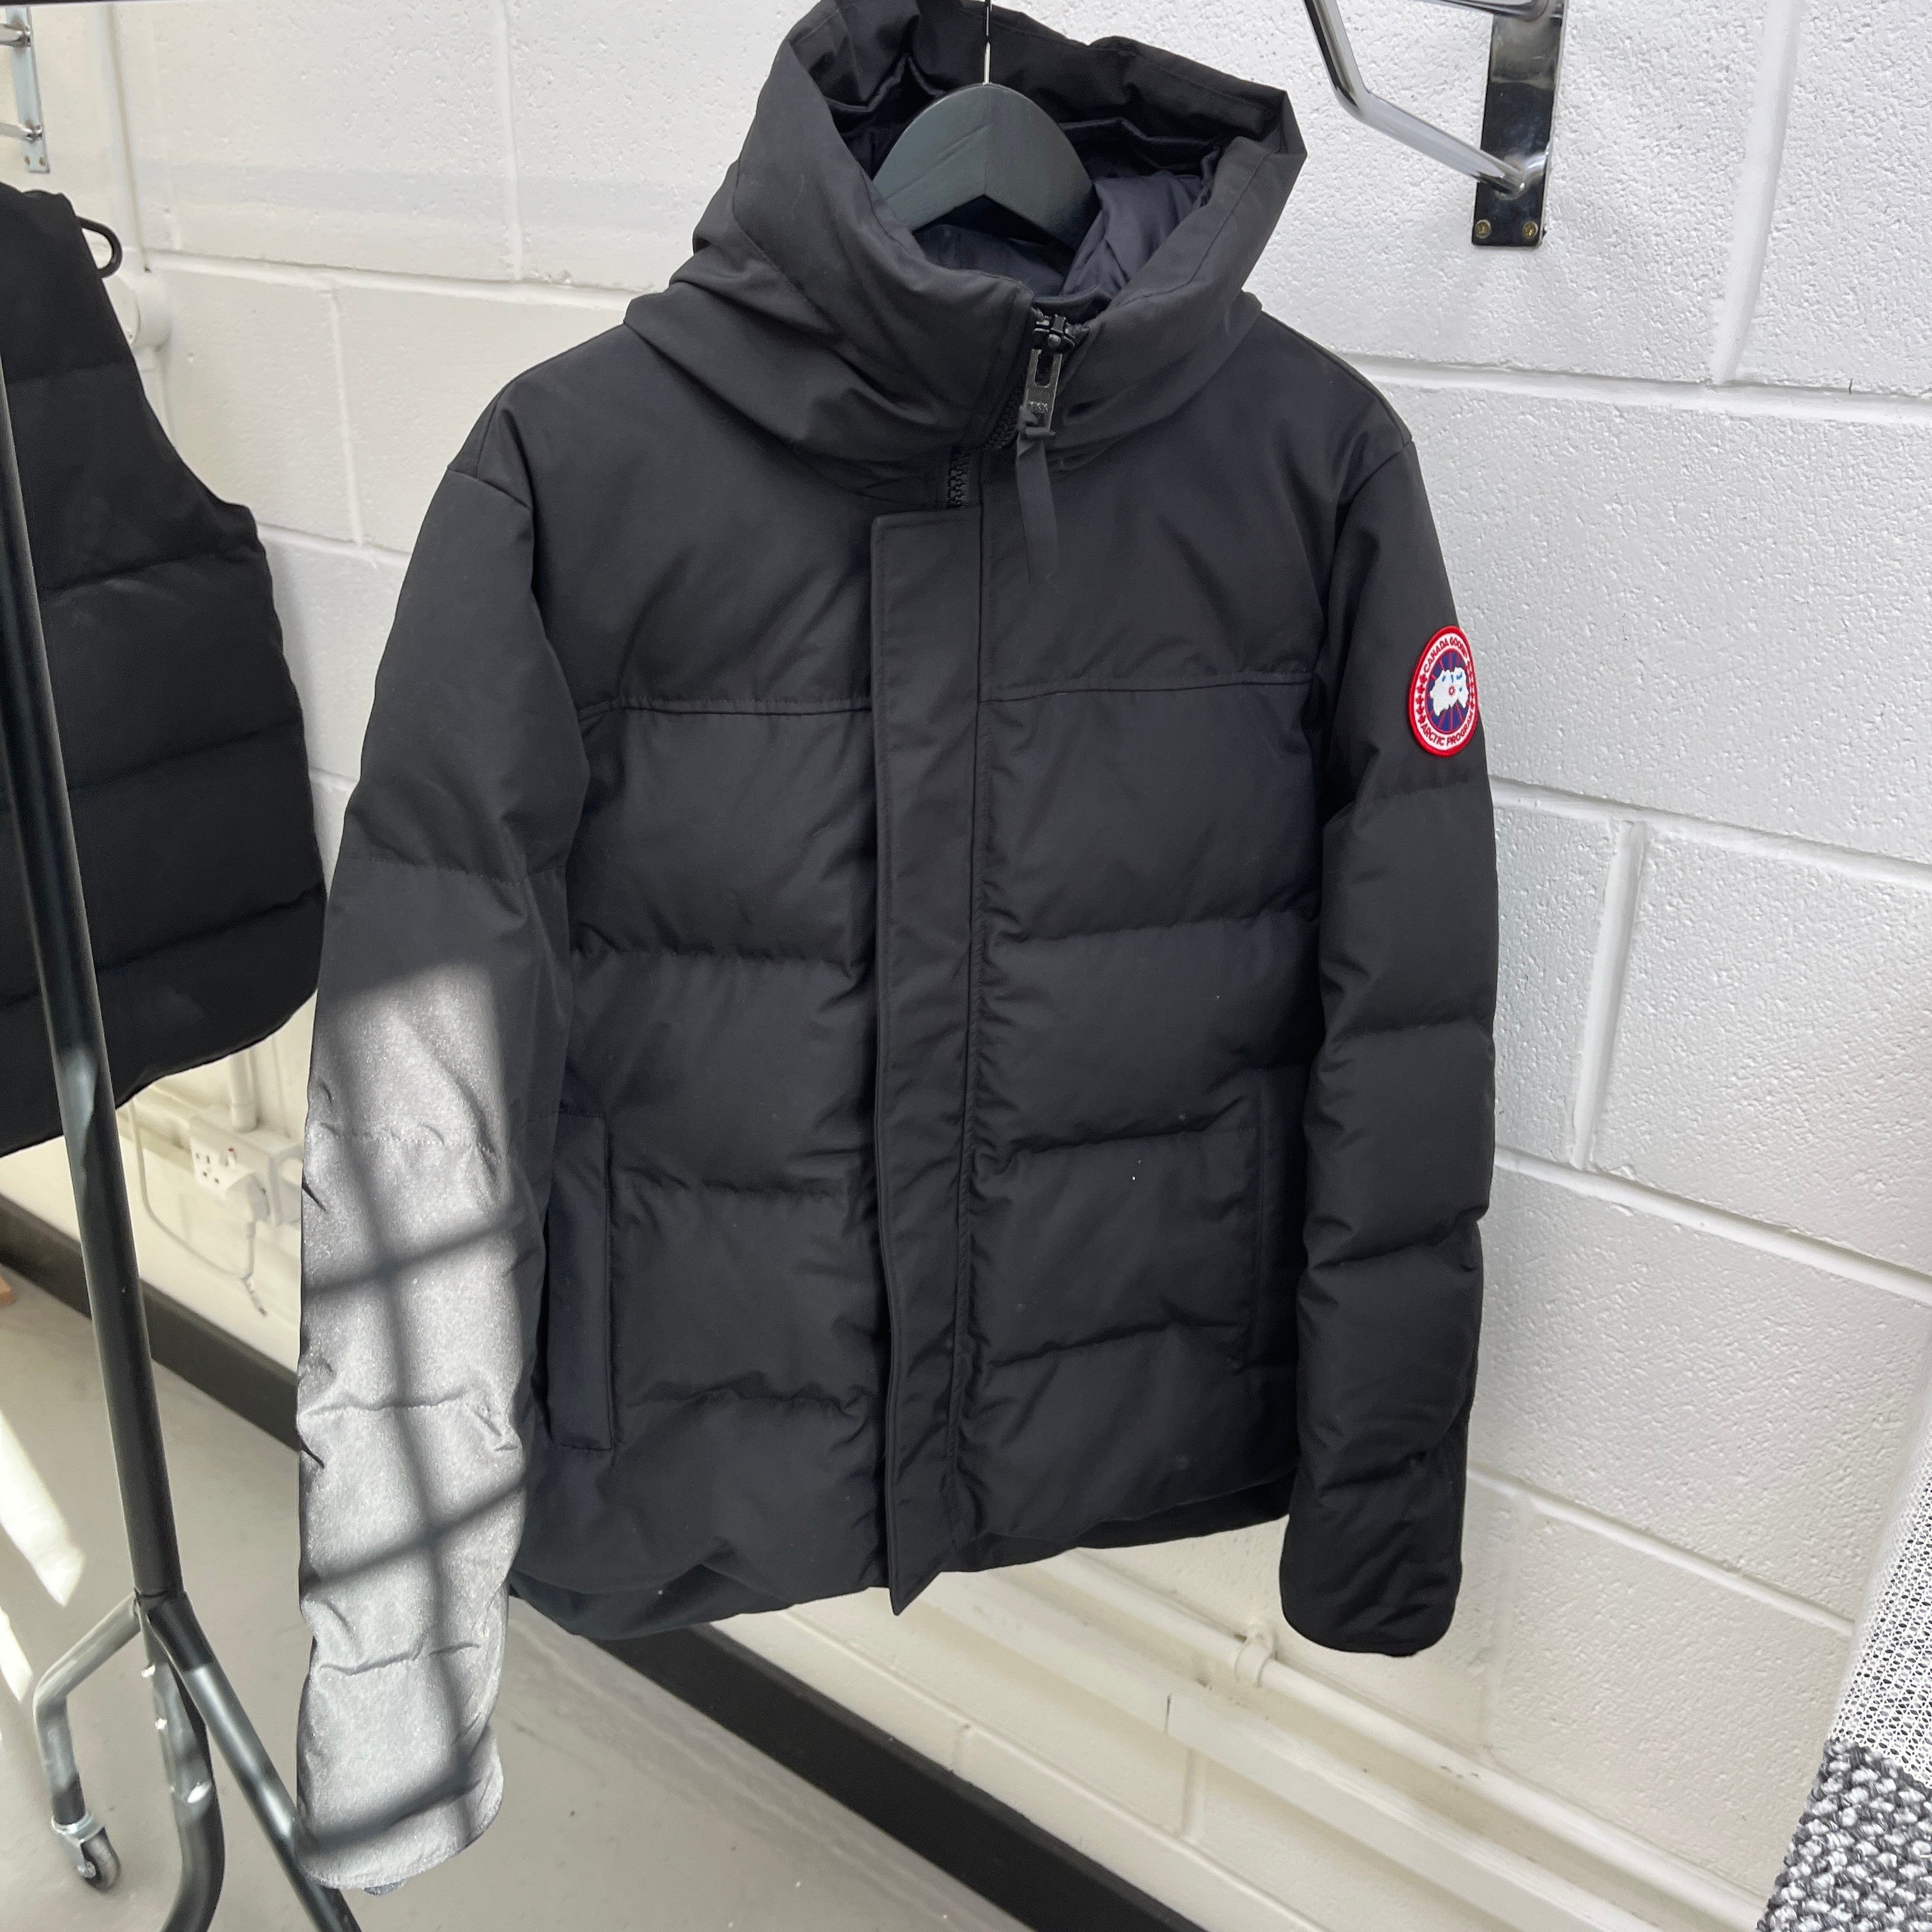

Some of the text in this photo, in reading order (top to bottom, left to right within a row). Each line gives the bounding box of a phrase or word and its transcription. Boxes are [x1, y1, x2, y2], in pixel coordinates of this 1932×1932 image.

[1423, 638, 1449, 673] CANADA
[1420, 710, 1473, 746] ARCTIC PROGRAM
